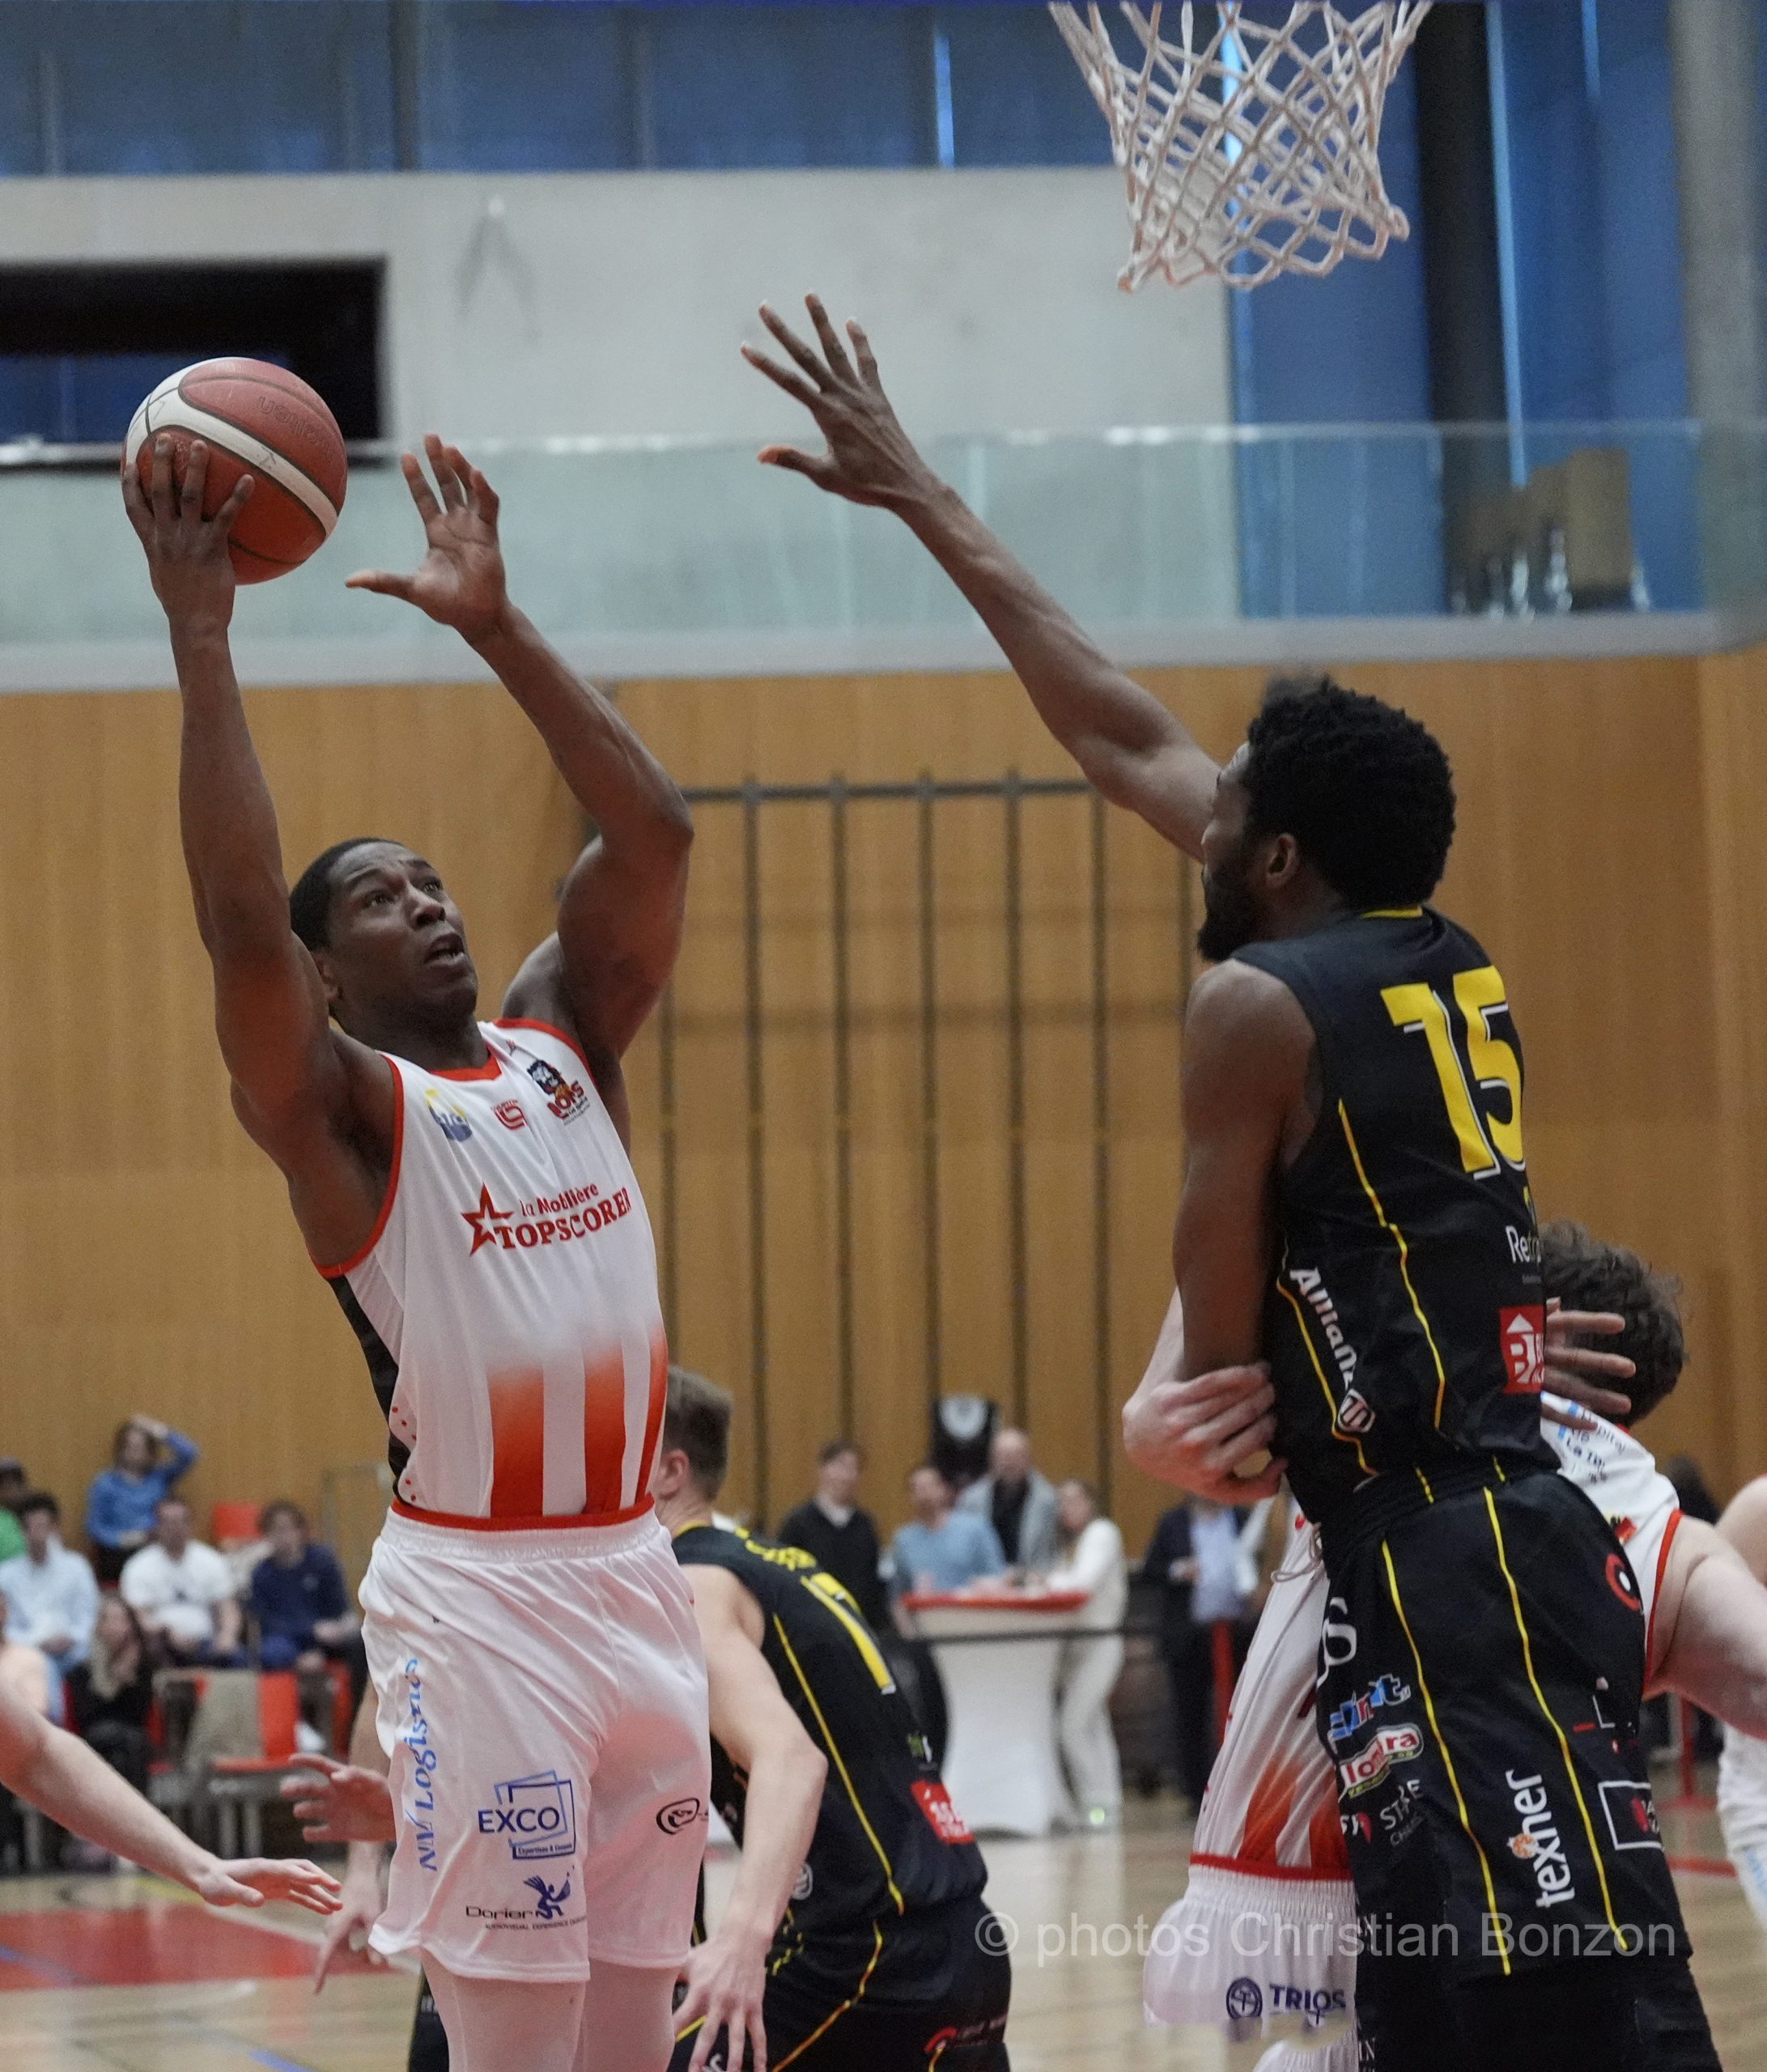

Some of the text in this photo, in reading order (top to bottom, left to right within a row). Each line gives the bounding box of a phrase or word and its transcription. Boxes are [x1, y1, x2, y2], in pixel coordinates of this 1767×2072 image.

[1379, 965, 1526, 1181] 15
[478, 1806, 559, 1834] EXCO
[1506, 1771, 1575, 1909] texner
[465, 1905, 533, 1921] Dorier
[1269, 1984, 1346, 2010] TRIOS
